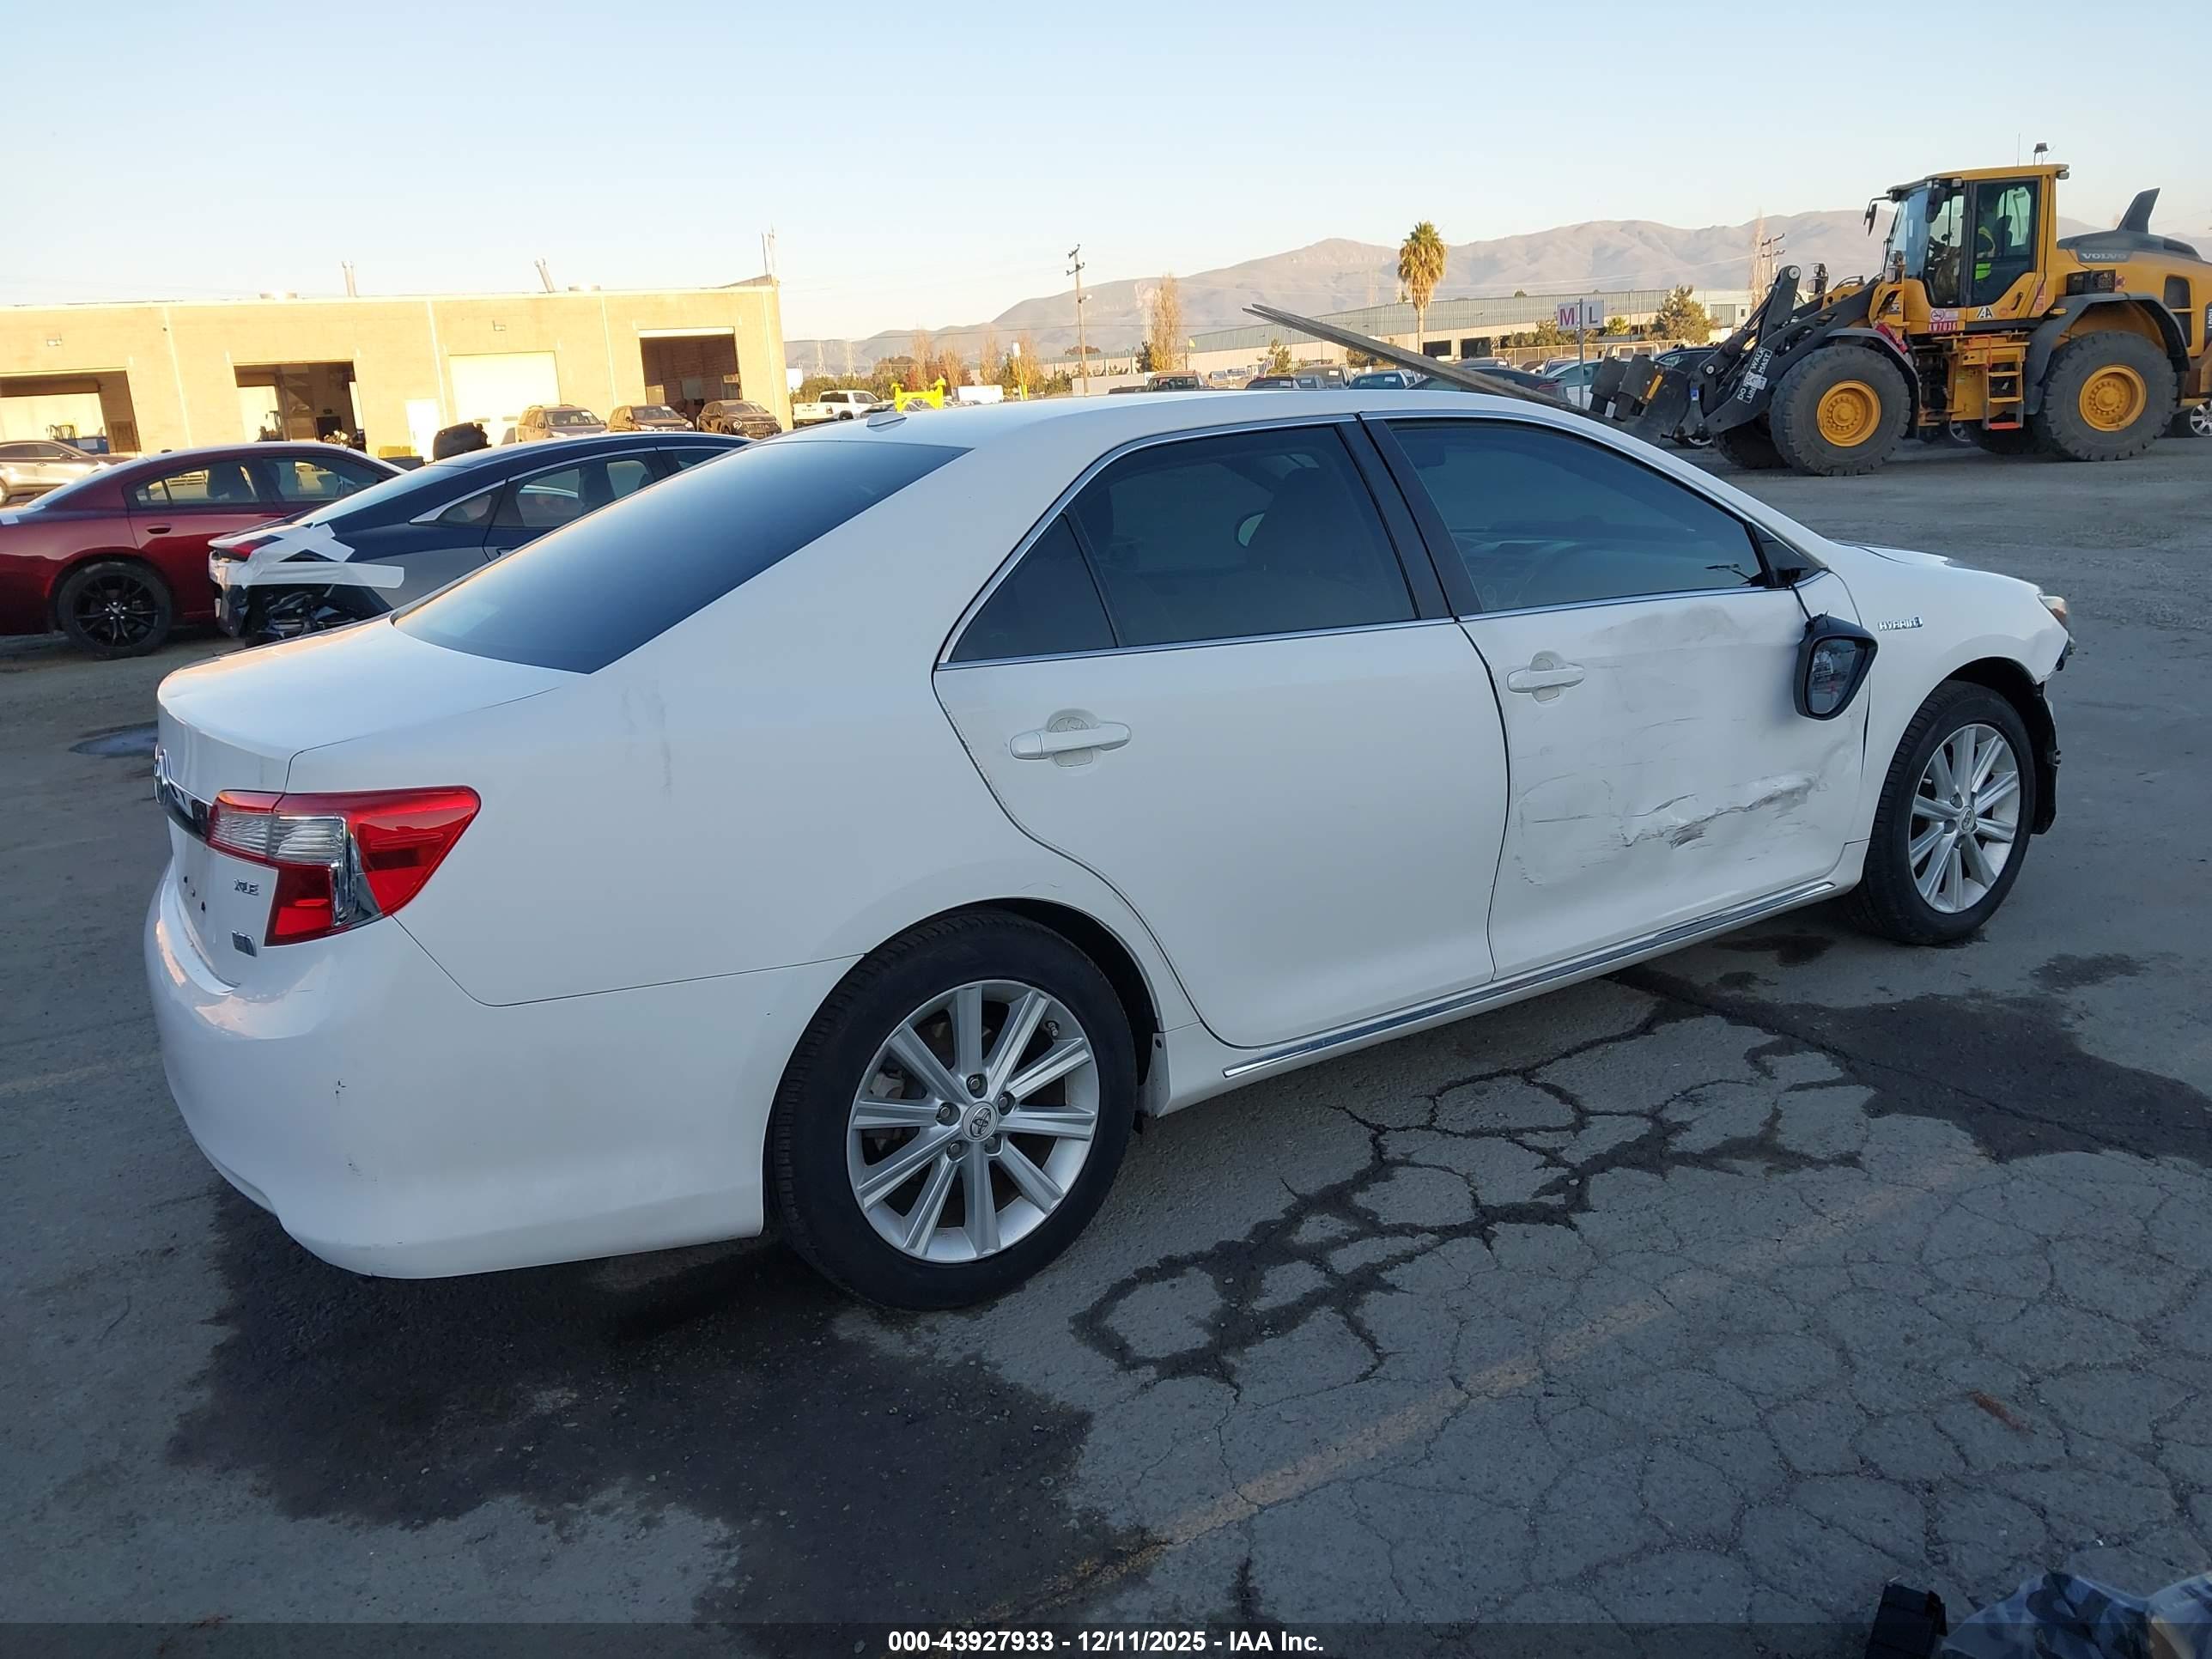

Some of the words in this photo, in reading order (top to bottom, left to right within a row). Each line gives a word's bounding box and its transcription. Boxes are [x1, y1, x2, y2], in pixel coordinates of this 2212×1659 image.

[1559, 307, 1575, 326] M
[1589, 306, 1598, 324] L
[1758, 353, 1770, 374] MAST
[1736, 387, 1747, 400] DO
[1750, 348, 1765, 369] WALK
